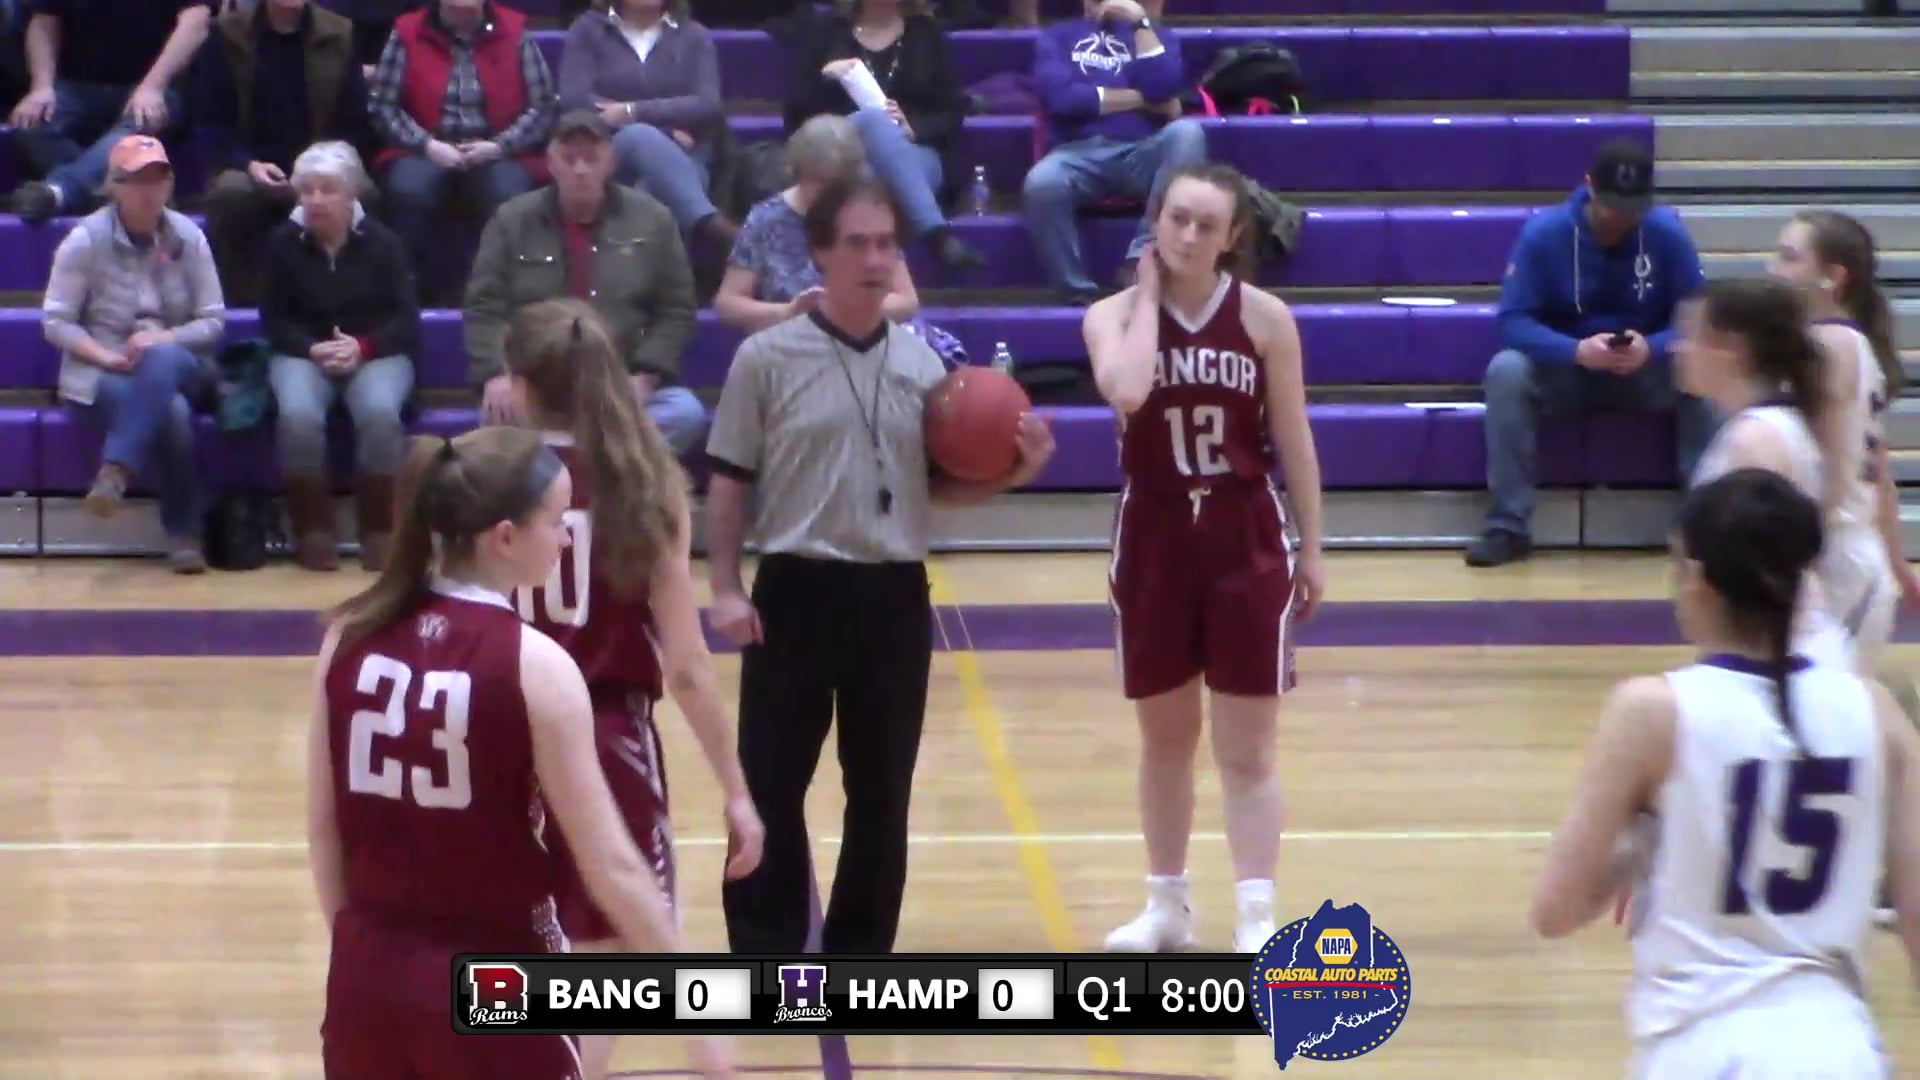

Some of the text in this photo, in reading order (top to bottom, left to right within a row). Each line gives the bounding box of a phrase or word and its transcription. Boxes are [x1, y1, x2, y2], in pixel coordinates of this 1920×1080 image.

[1151, 347, 1257, 397] ANGOR
[1164, 405, 1232, 476] 12
[350, 653, 472, 810] 23
[1719, 757, 1857, 915] 15
